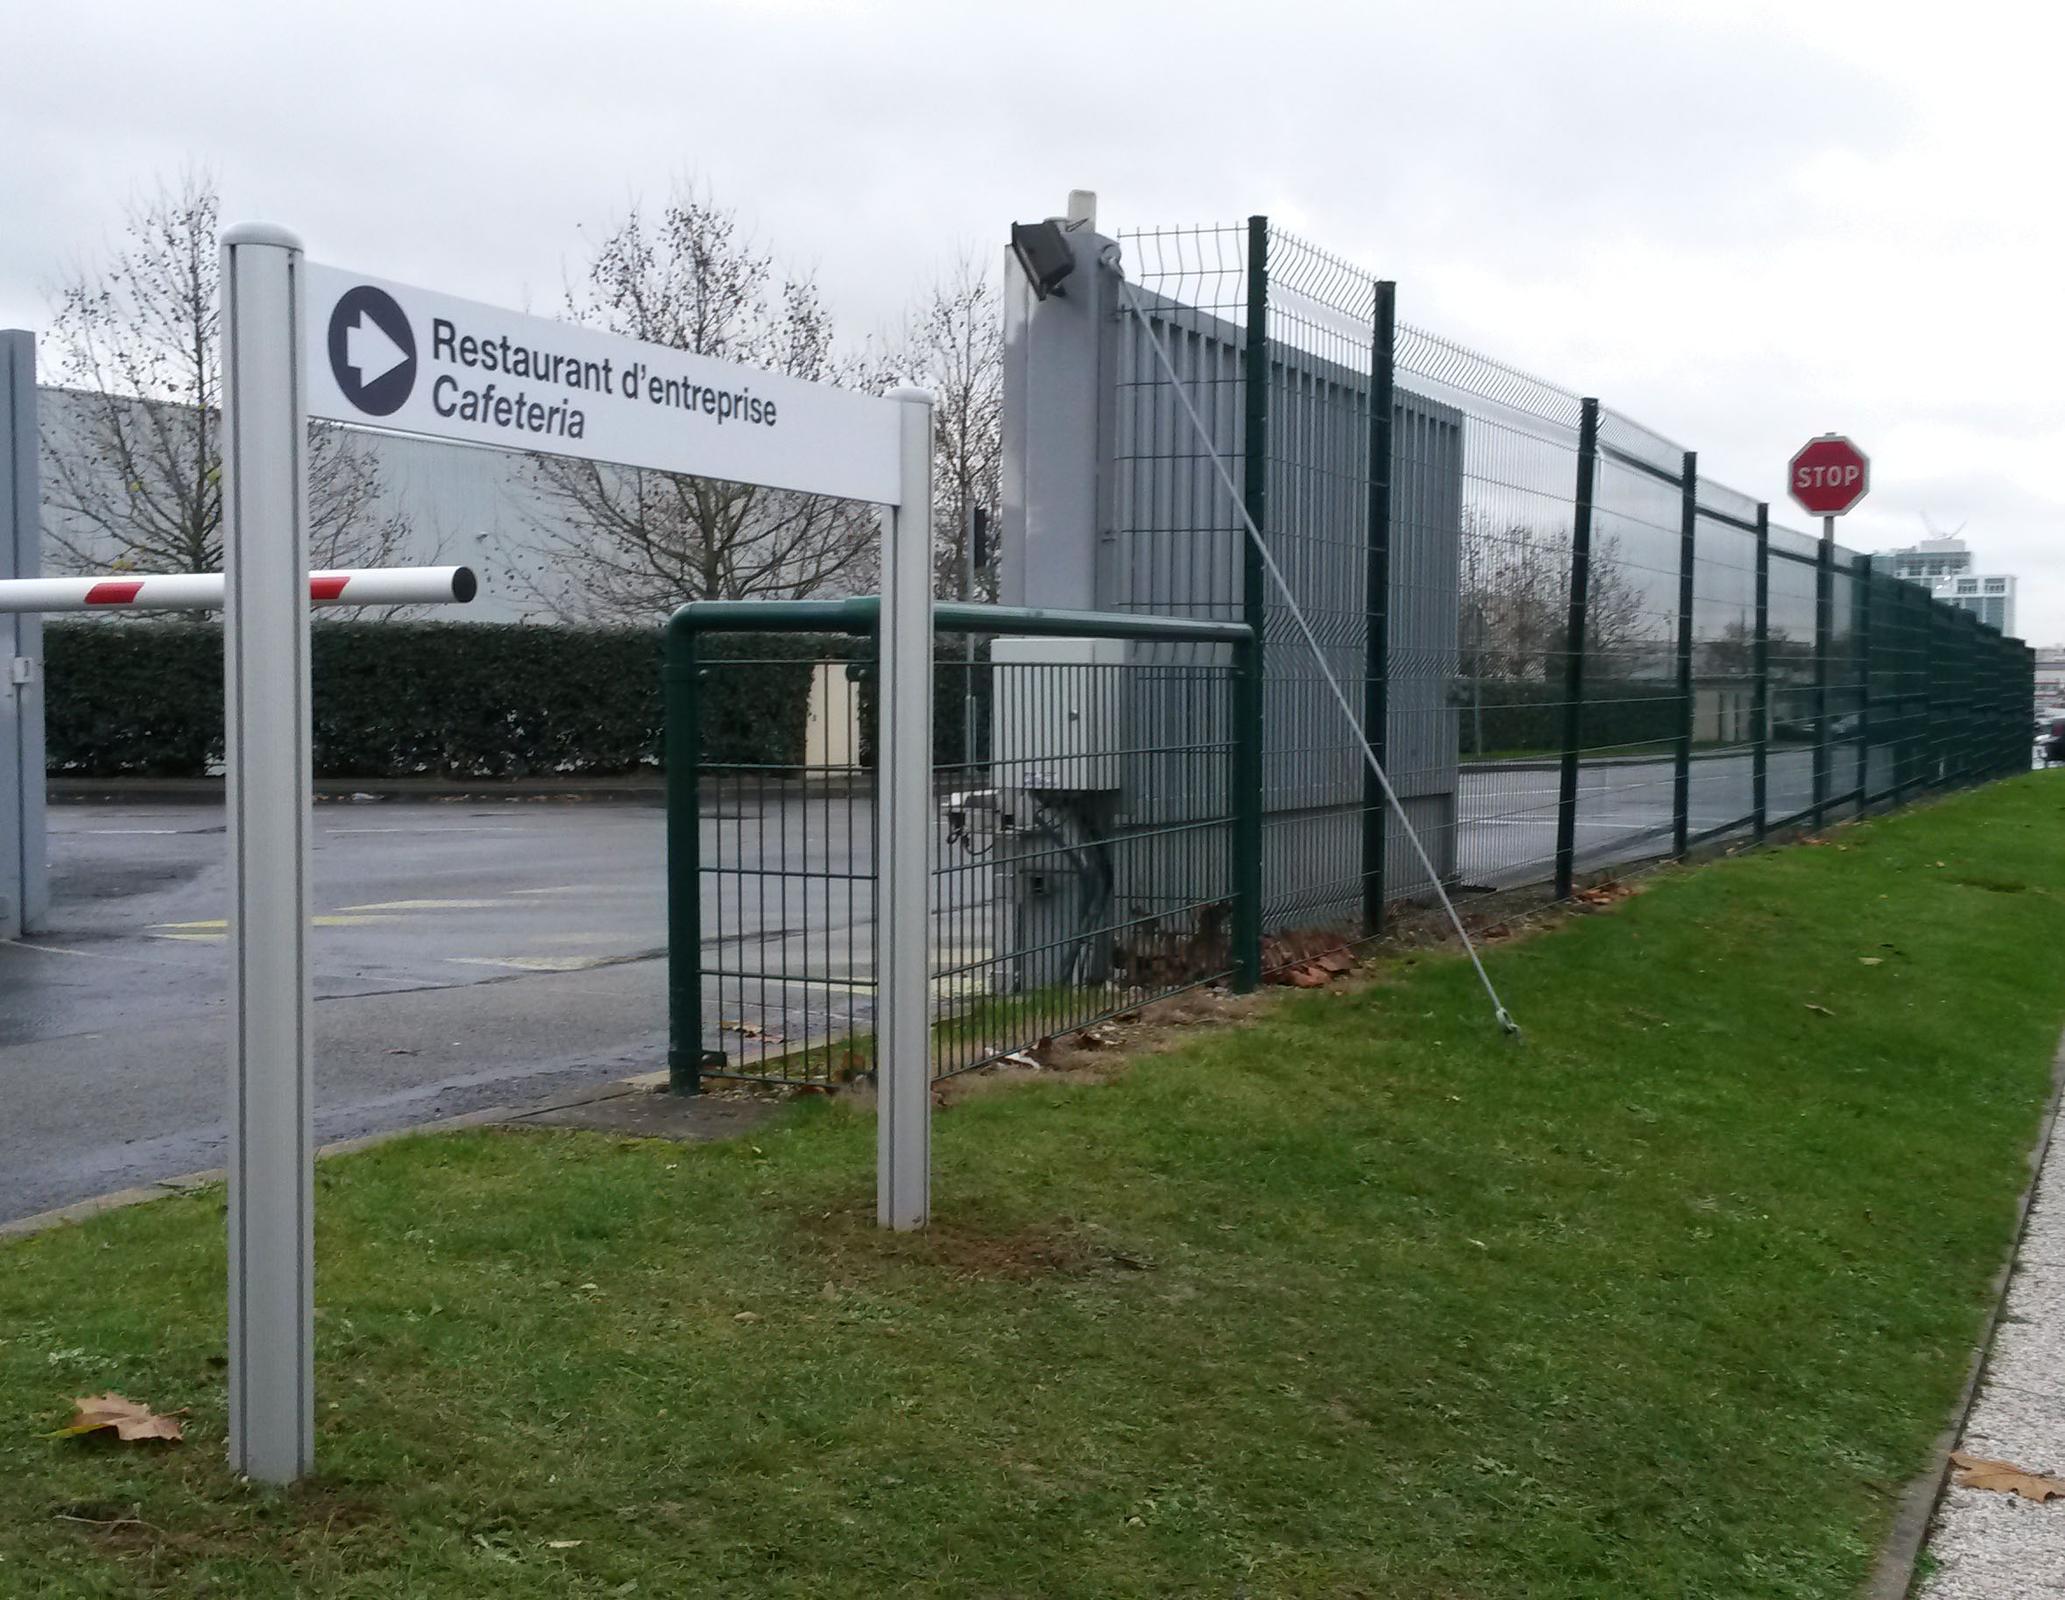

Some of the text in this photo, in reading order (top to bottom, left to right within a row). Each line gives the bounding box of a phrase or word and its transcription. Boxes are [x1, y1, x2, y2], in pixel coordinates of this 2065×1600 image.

[433, 318, 777, 427] Restaurant d'entreprise
[433, 375, 585, 439] Cafeteria
[1796, 465, 1859, 488] STOP
